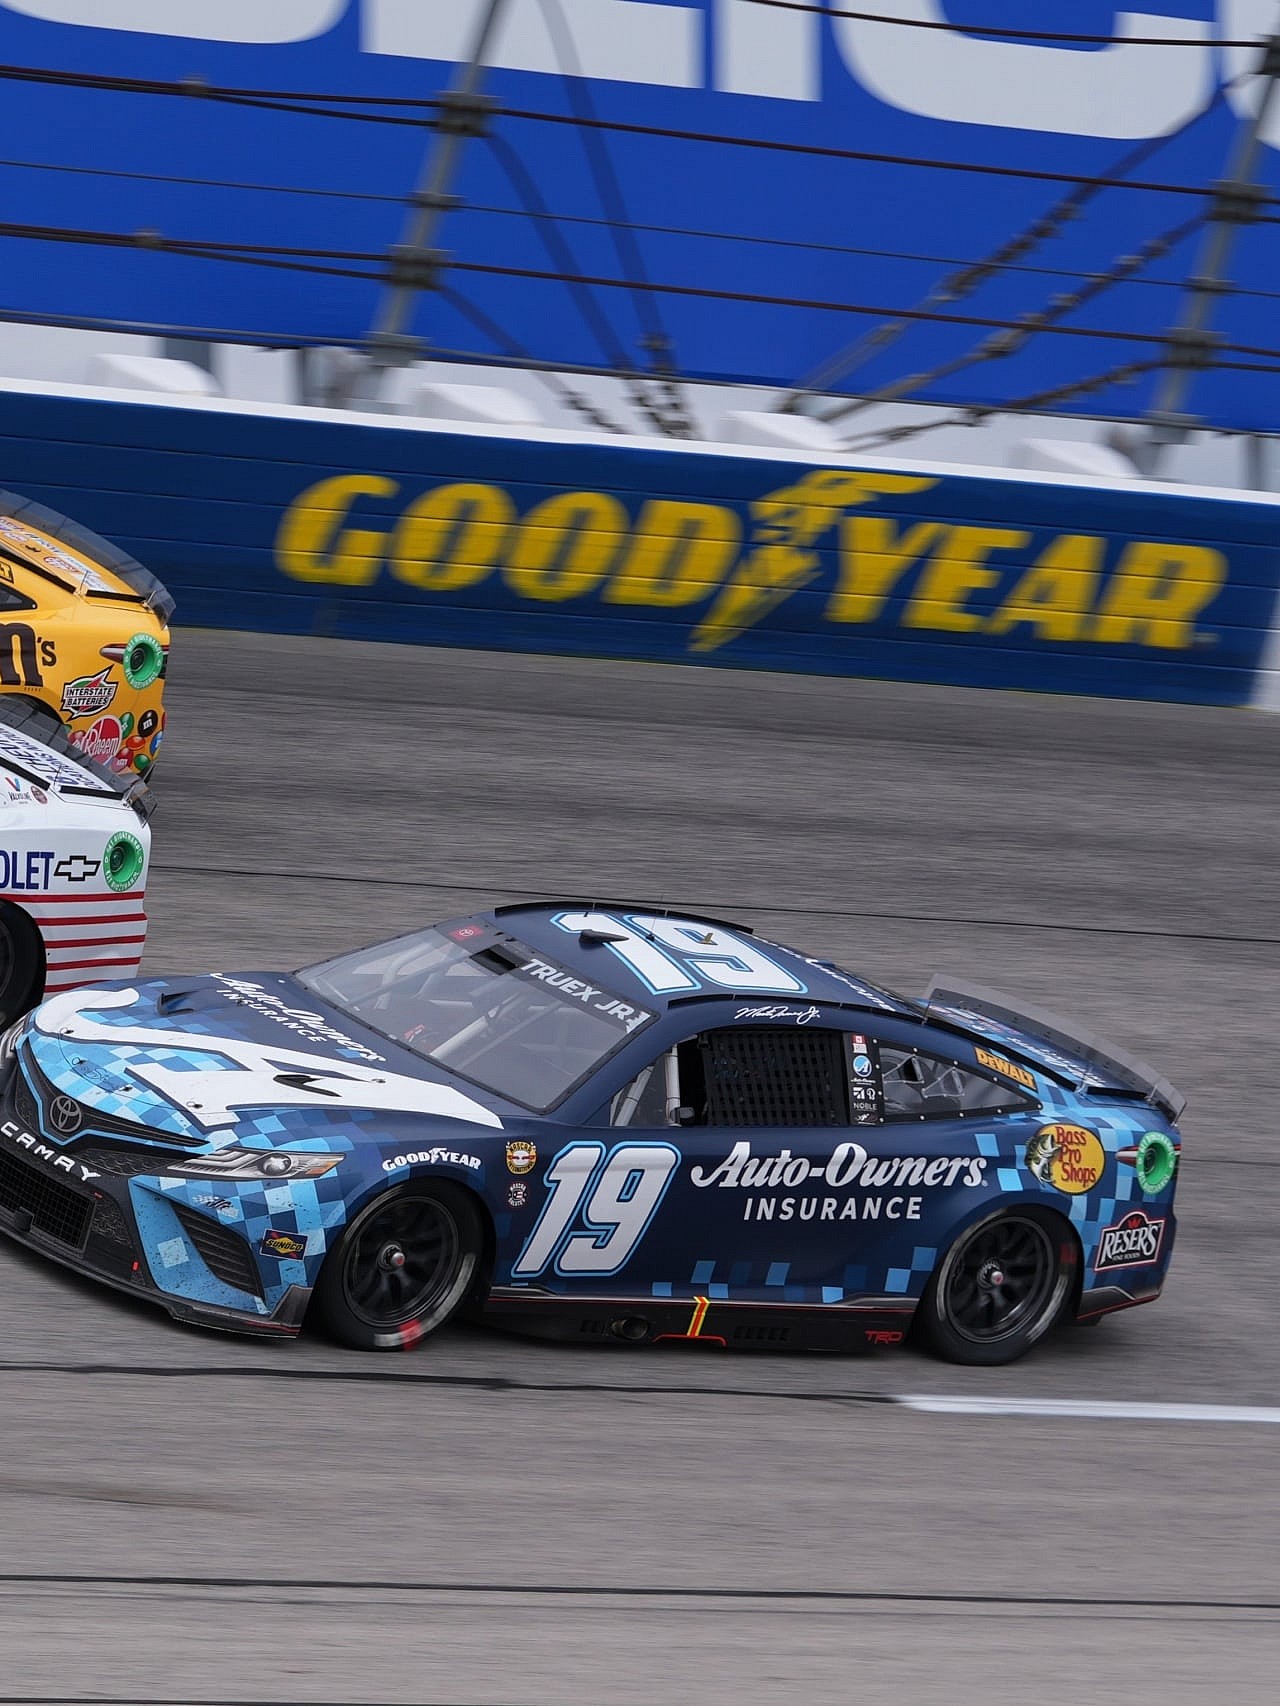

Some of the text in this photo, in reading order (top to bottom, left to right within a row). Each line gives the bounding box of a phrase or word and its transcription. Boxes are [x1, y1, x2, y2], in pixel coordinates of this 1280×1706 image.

[66, 687, 113, 696] INTERSTATE
[67, 697, 109, 706] BATTERIES
[83, 728, 119, 758] Rheem
[550, 911, 808, 995] 19
[520, 959, 602, 1002] TRUEX
[210, 973, 386, 1061] Auto-Owners
[216, 990, 327, 1042] INSURANCE
[1056, 1127, 1086, 1145] Bass
[0, 1121, 101, 1181] CAMRY
[382, 1148, 481, 1169] GOODYEAR
[1058, 1145, 1081, 1162] Pro
[690, 1142, 987, 1187] Auto-Owners
[1061, 1162, 1096, 1187] Shops
[511, 1140, 681, 1277] 19
[744, 1196, 922, 1220] INSURANCE
[267, 1239, 303, 1251] SUNOCO
[865, 1330, 903, 1343] TRD
